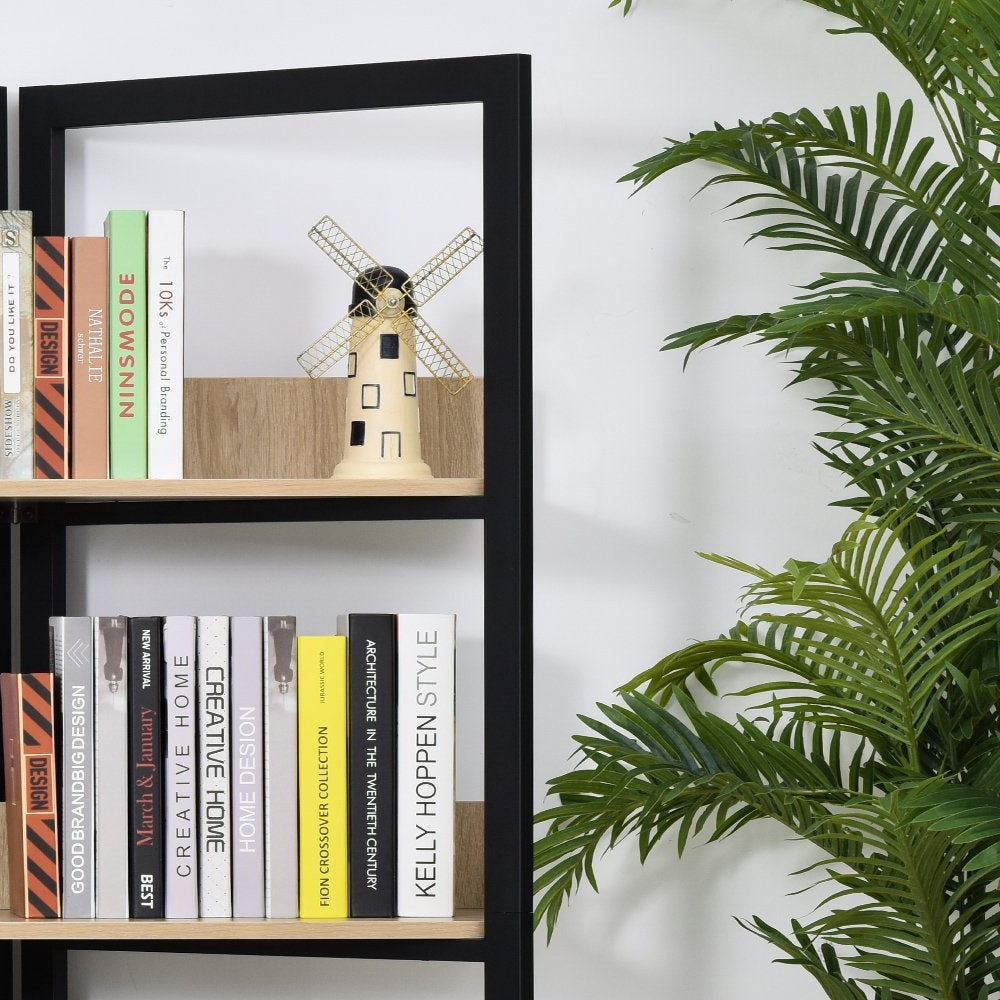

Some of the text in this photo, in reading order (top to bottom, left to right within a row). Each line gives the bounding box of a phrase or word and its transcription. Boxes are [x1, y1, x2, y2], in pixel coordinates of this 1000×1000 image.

[7, 299, 16, 325] LIKE
[159, 280, 174, 318] 10Ks
[8, 328, 16, 352] YOU
[8, 356, 16, 373] DO
[40, 321, 59, 374] DESIGN
[88, 308, 103, 383] NATHALIE
[119, 274, 134, 418] NINSWODE
[160, 331, 170, 381] Personal
[157, 386, 170, 435] Branding
[142, 629, 151, 689] NEW ARRIVAL
[28, 757, 49, 811] DESIGN
[136, 706, 156, 847] March & January
[174, 656, 192, 878] CREATIVE HOME
[206, 666, 225, 853] CREATIVE HOME
[366, 639, 377, 890] ARCHITECTURE IN THE TWENTIETH CENTURY
[415, 630, 438, 898] KELLY HOPPEN STYLE
[239, 792, 255, 852] HOME
[318, 726, 330, 907] FION CROSSOVER COLLECTION
[140, 874, 154, 909] BEST
